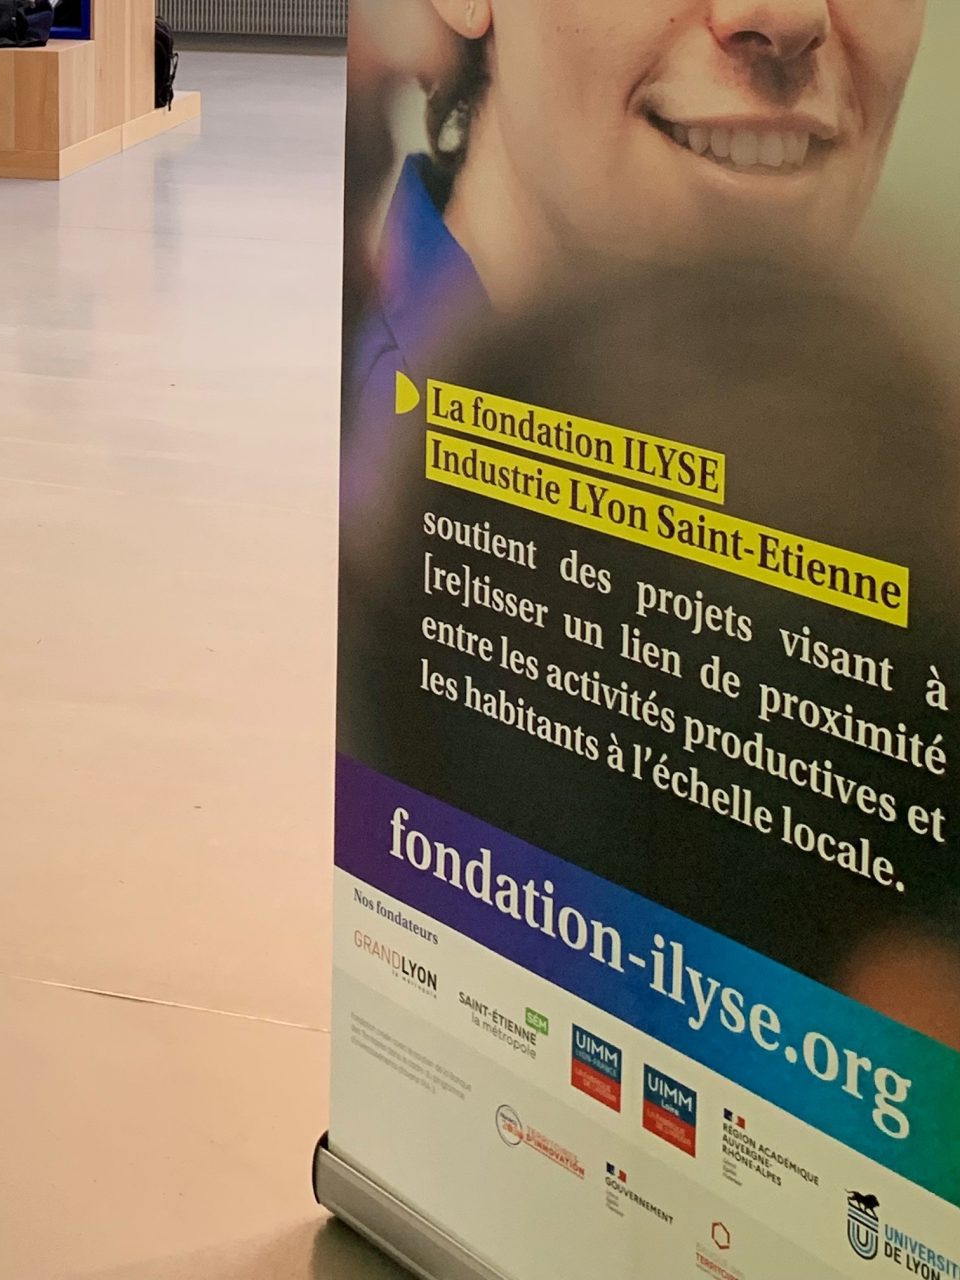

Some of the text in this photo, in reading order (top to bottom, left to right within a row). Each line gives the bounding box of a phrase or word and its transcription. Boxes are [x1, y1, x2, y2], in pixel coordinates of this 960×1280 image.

[432, 386, 720, 494] La fondation ILYSE
[431, 439, 902, 610] Industrie LYon Saint-Etienne
[423, 510, 948, 711] soutient des projets visant à
[423, 551, 947, 775] [re]tisser un lien de proximité
[421, 614, 946, 843] entre les activités productives et
[421, 658, 906, 893] les habitants à l'échelle locale.
[354, 887, 439, 945] Nos fondateurs
[388, 807, 912, 1140] fondation-ilyse.org
[458, 991, 537, 1046] SAINT-ÉTIENNE
[471, 1013, 537, 1060] la métropole
[576, 1030, 618, 1068] UIMM
[648, 1073, 692, 1112] UIMM
[722, 1134, 773, 1168] AUVERGNE-
[605, 1176, 674, 1225] GOUVERNEMENT
[884, 1241, 941, 1280] DE LYON
